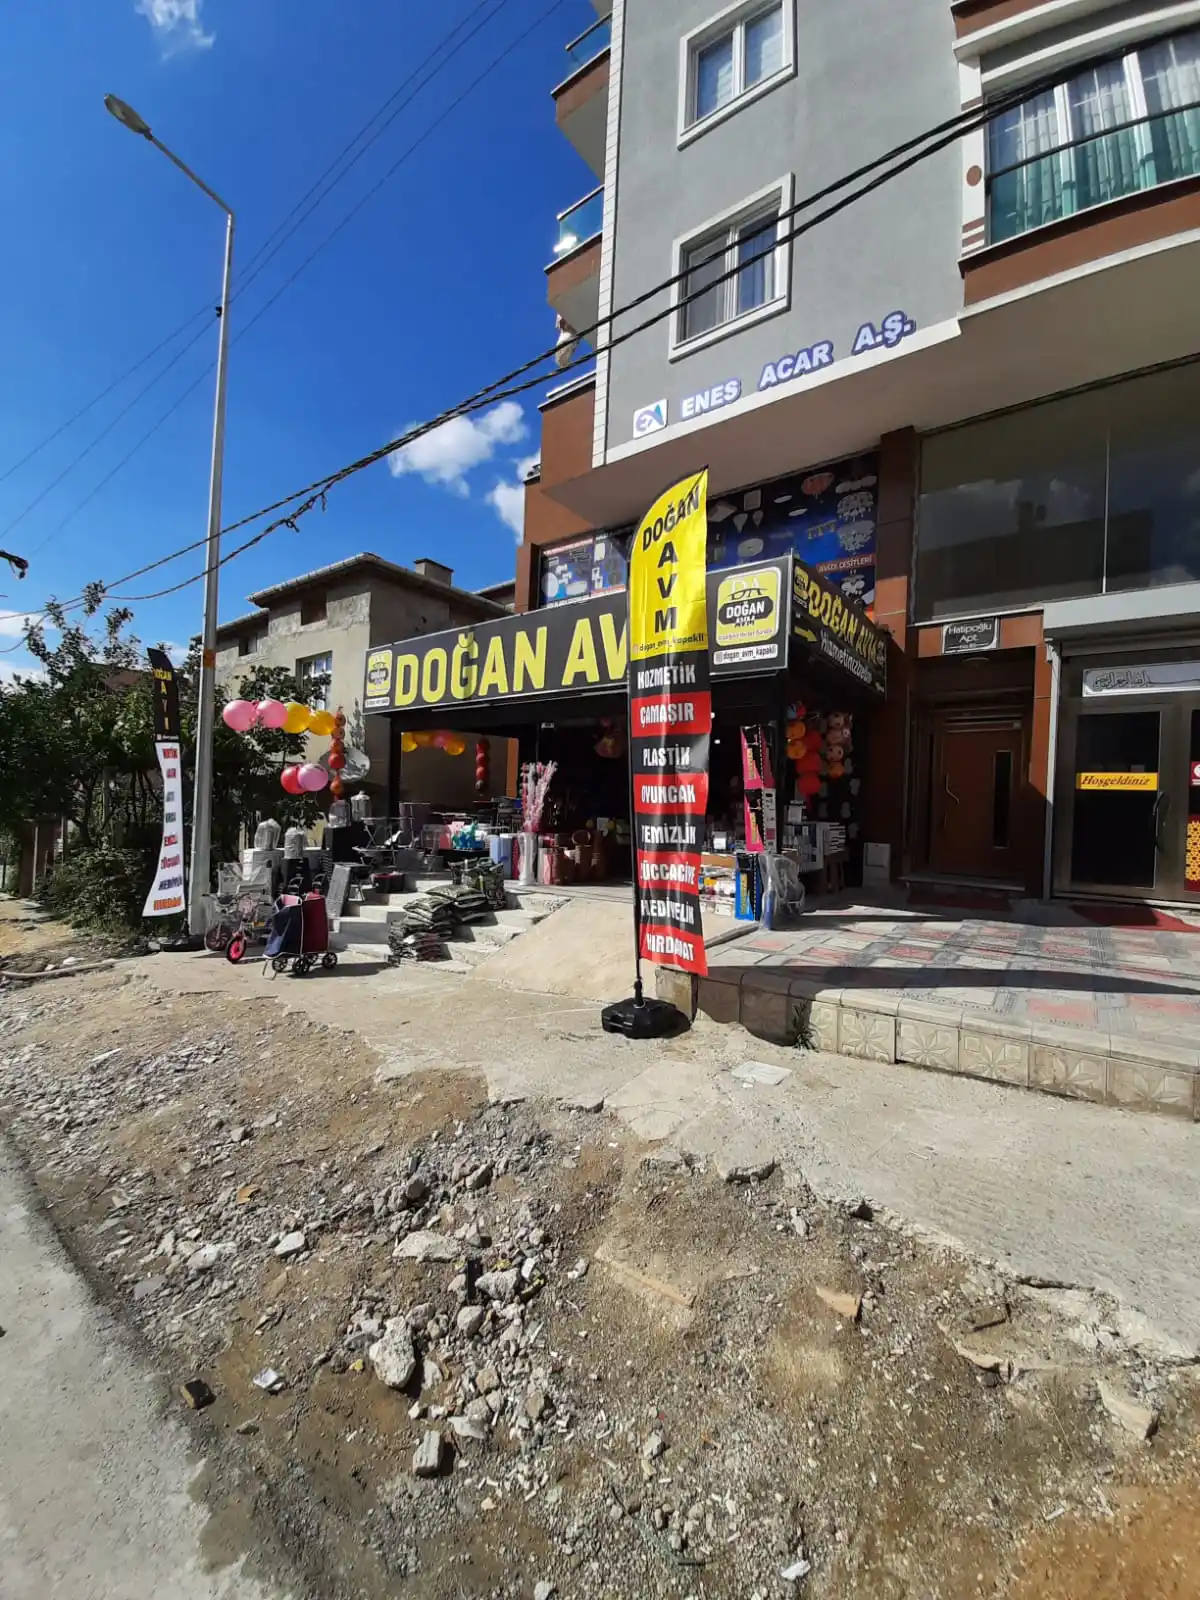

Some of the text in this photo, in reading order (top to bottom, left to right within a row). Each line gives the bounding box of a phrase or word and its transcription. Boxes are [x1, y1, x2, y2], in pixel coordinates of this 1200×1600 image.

[681, 379, 741, 421] ENES
[758, 340, 834, 391] ACAR
[852, 311, 916, 355] A.Ş.
[642, 485, 700, 552] DOĞAN
[725, 600, 766, 620] DOĞAN
[734, 615, 756, 628] AVM
[809, 579, 859, 647] DOĞAN
[394, 626, 547, 707] DOĞAN
[637, 661, 696, 690] KOZMETİK
[640, 702, 694, 728] ÇAMAŞIR
[643, 744, 691, 767] PLASTİK
[641, 784, 696, 804] OYUNCAK
[1079, 775, 1151, 788] Hoşgeldiniz
[640, 860, 696, 885] ÜCCACİYE
